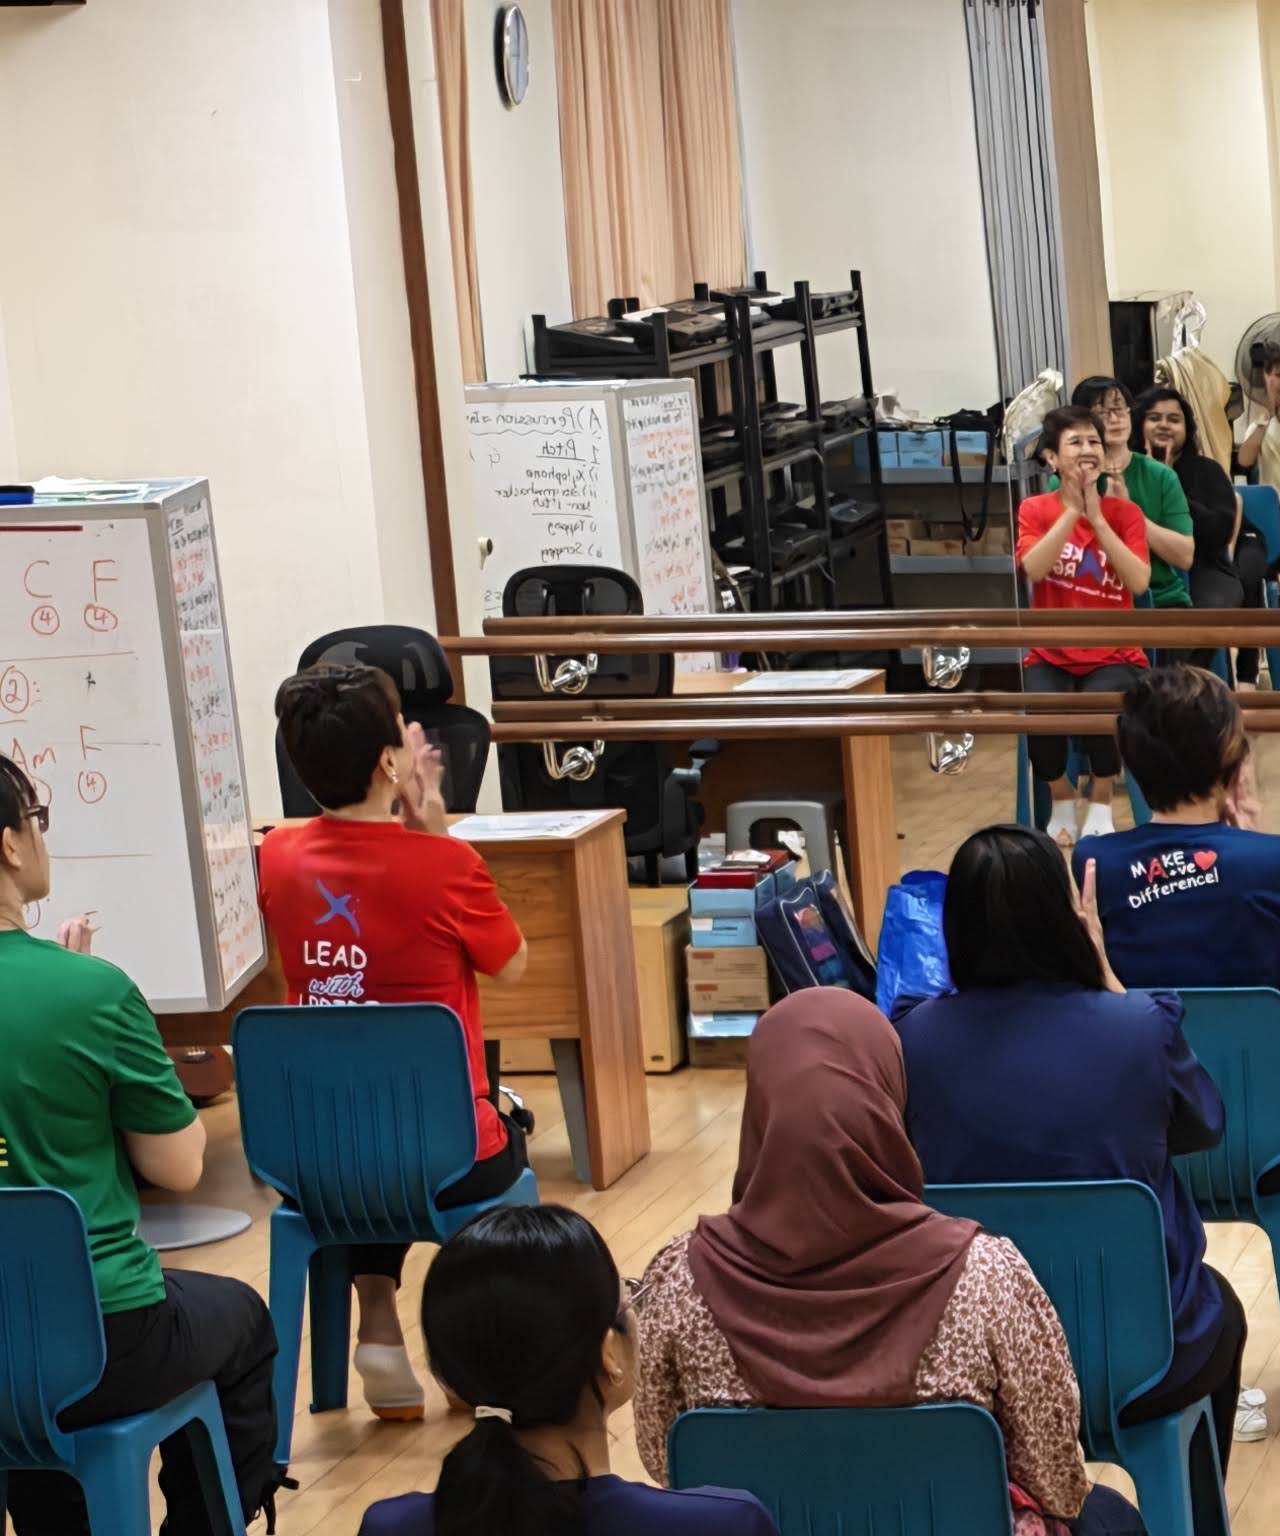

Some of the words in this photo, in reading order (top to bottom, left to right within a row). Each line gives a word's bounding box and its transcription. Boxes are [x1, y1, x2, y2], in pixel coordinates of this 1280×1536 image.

[24, 559, 53, 598] C
[91, 559, 119, 602] F
[79, 724, 104, 761] F
[1130, 850, 1185, 883] MAKE
[304, 940, 367, 969] LEAD
[309, 971, 364, 998] with
